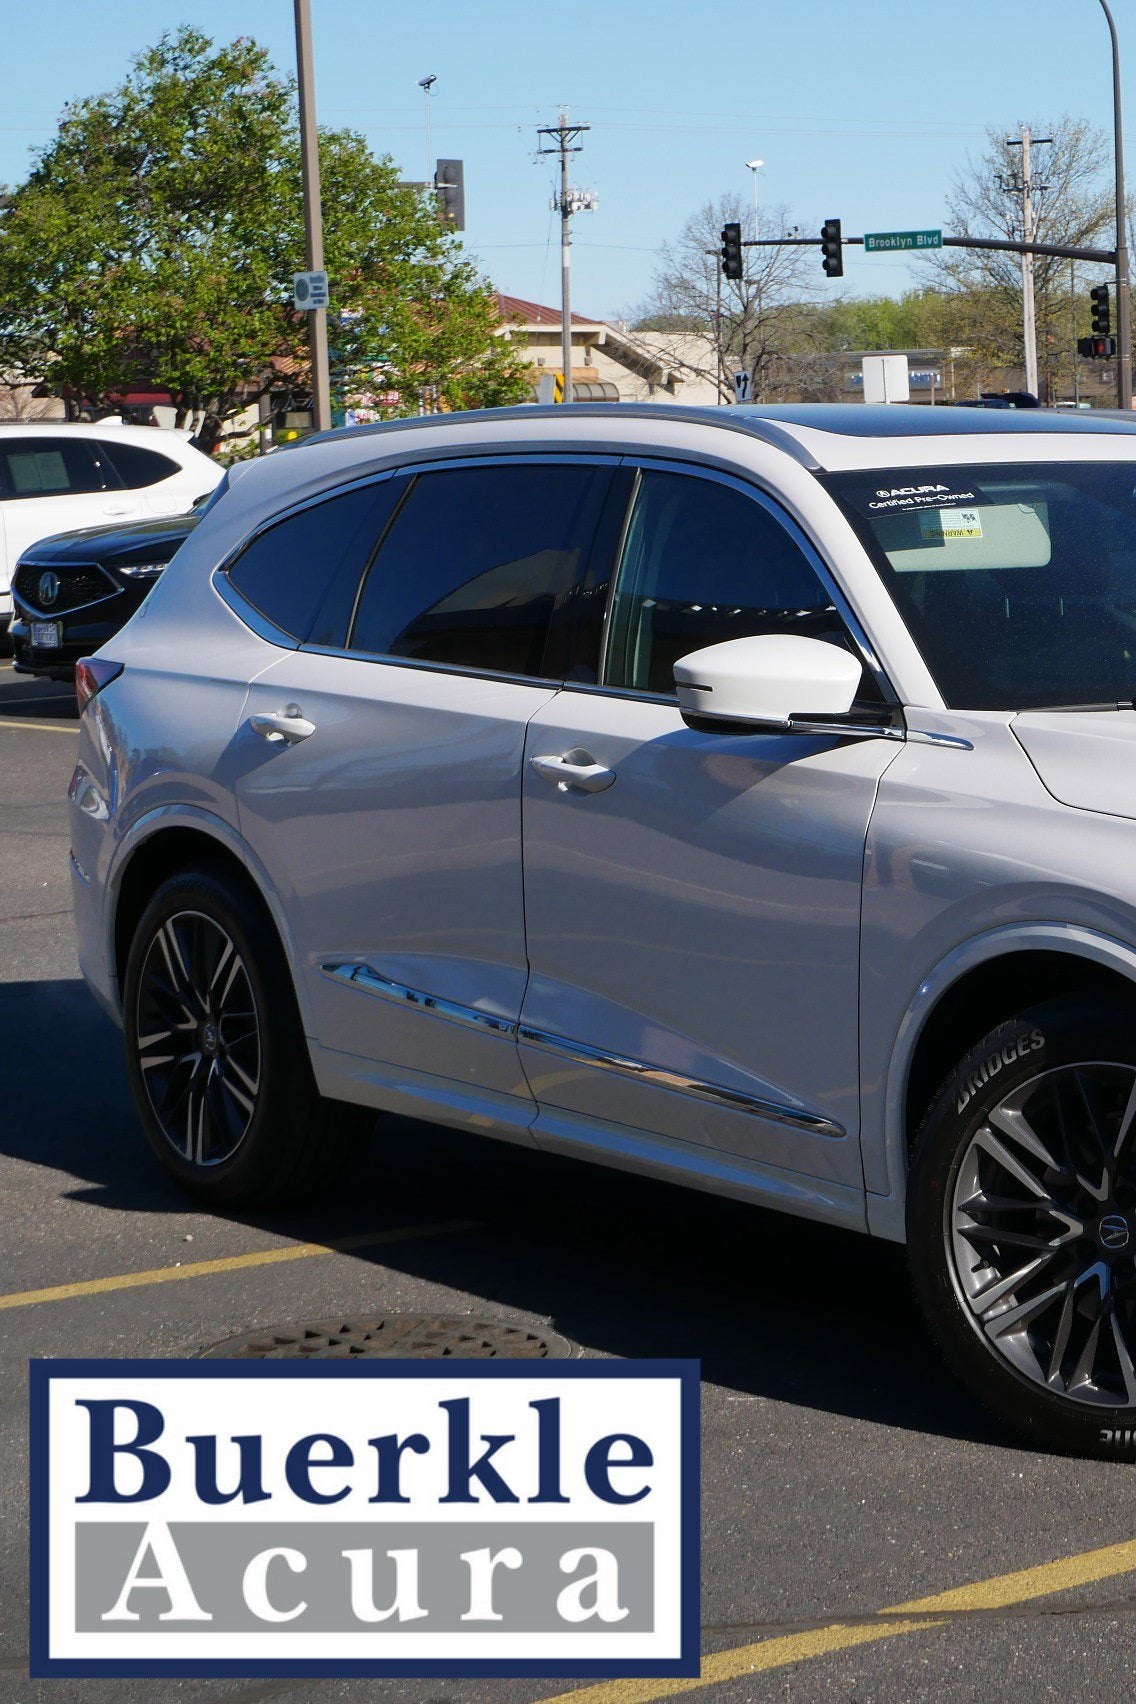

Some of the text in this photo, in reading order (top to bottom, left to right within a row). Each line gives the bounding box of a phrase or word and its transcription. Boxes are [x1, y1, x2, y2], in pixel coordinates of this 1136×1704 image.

[869, 234, 939, 248] Brooklyn Blvd
[890, 484, 950, 497] ACURA
[868, 497, 914, 509] Certified
[914, 492, 975, 505] Pre-Owned
